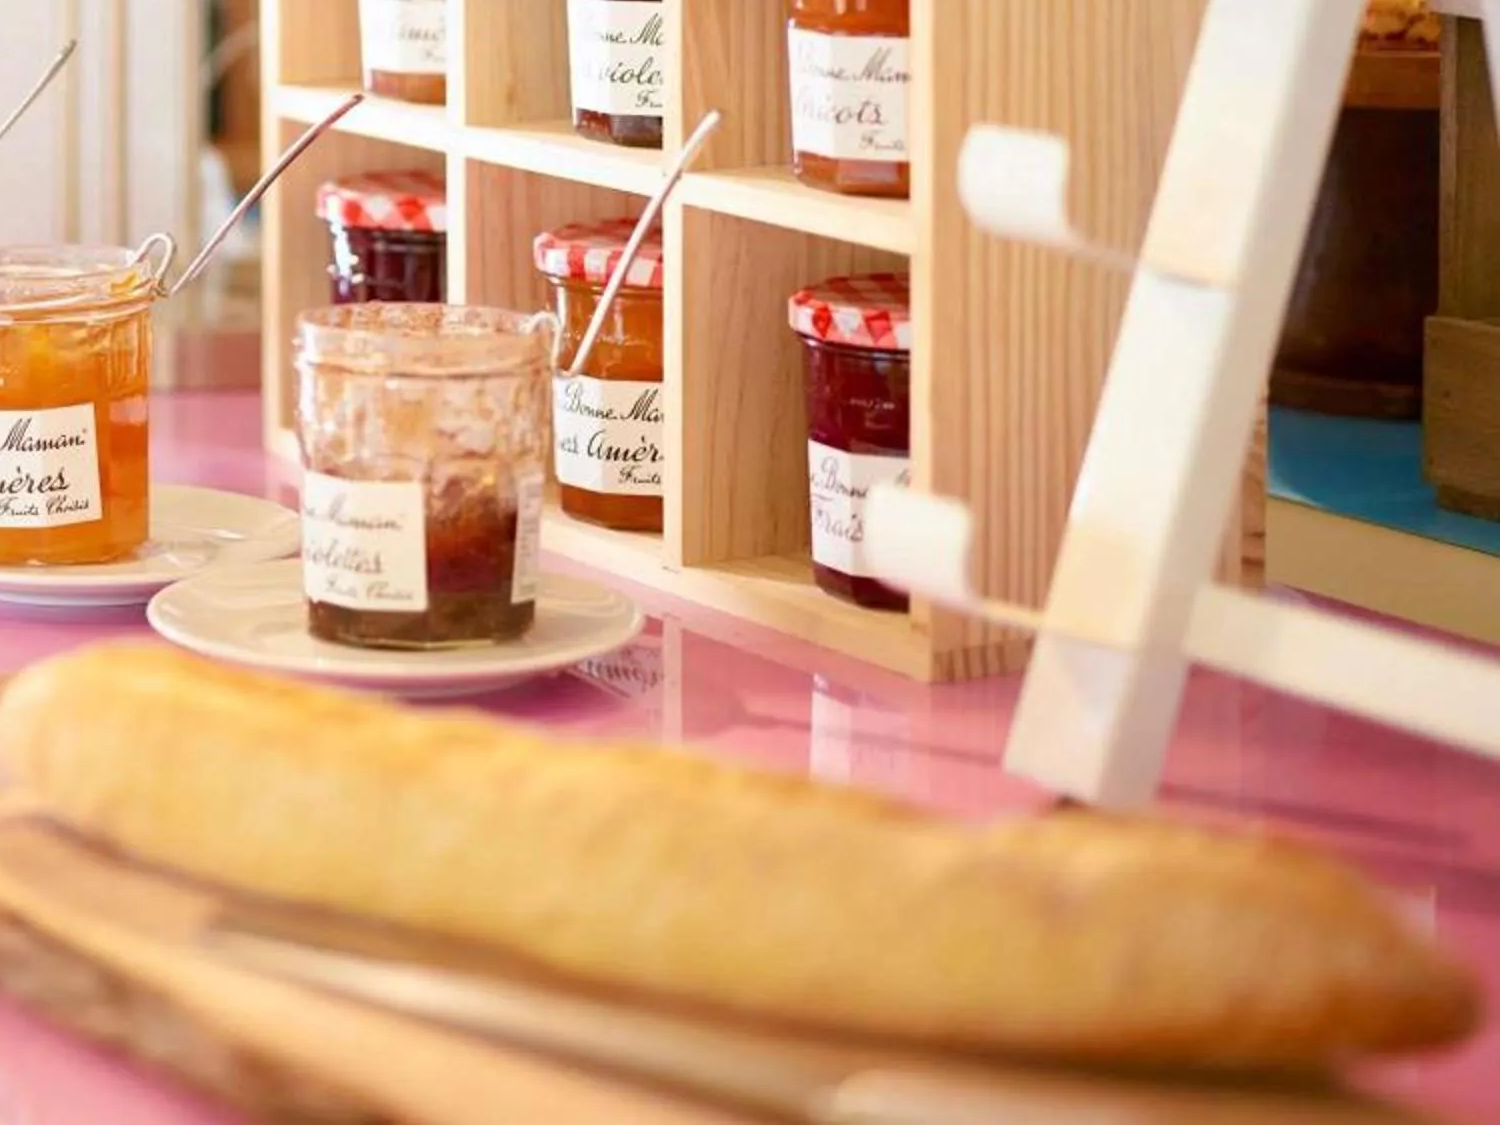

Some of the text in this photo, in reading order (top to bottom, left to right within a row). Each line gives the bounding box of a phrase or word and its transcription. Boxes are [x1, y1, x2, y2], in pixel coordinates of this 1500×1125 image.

[563, 381, 617, 420] Bonne
[586, 429, 664, 463] Amèr
[45, 494, 91, 517] Choisis
